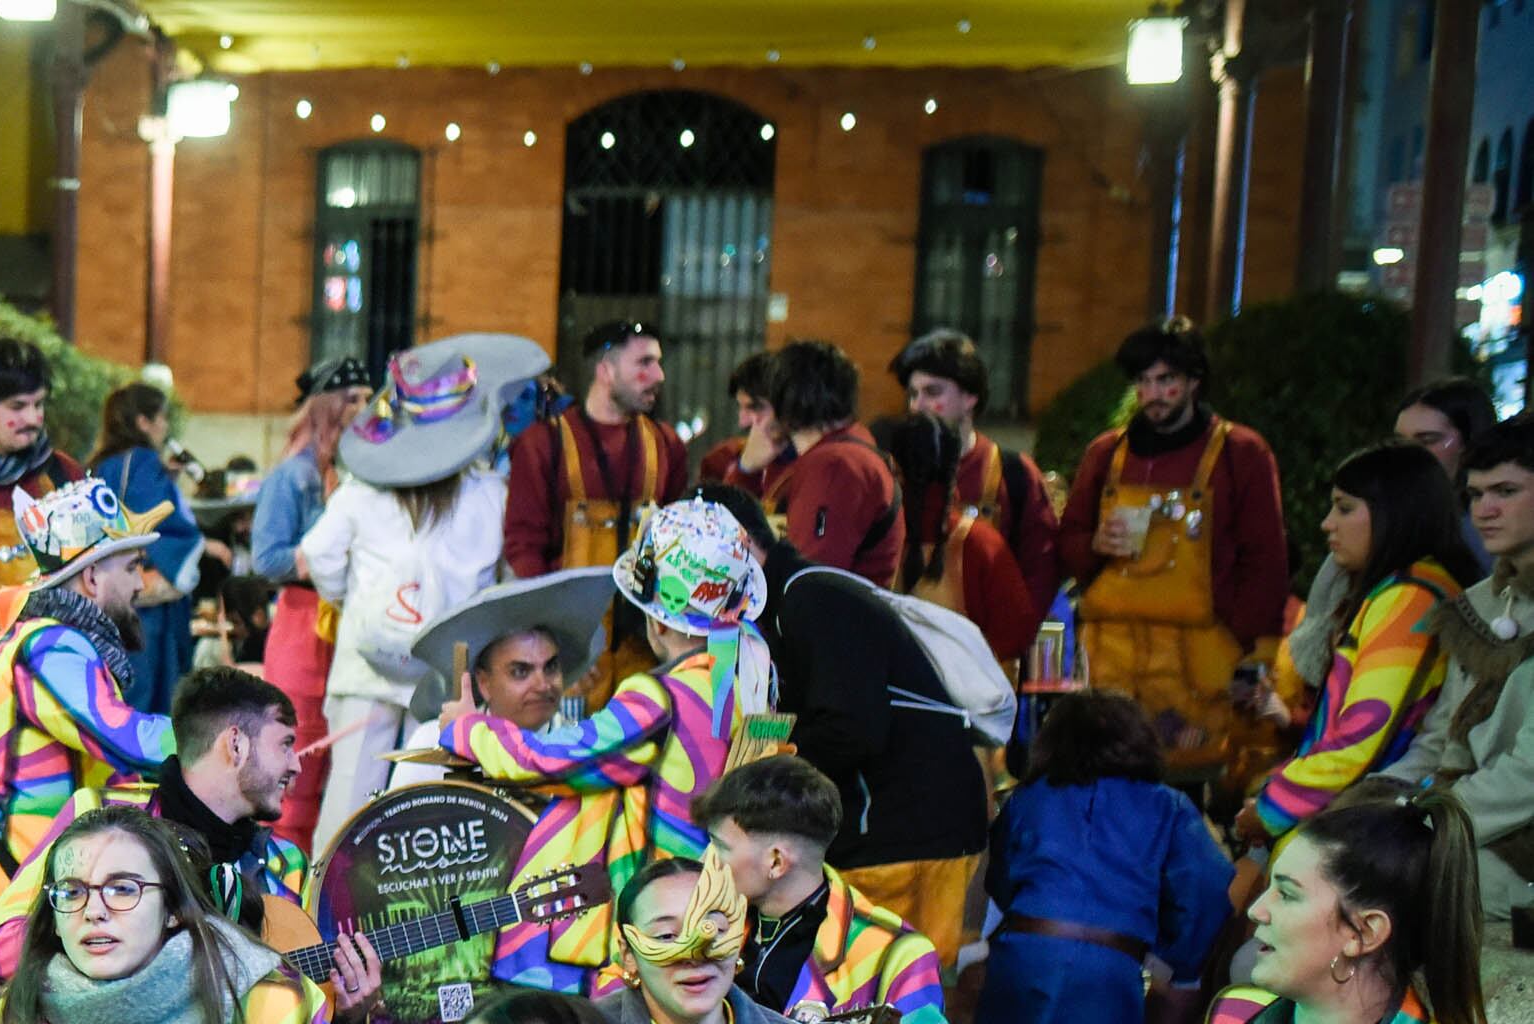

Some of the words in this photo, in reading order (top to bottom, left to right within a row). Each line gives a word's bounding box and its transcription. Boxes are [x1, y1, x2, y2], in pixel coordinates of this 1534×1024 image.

[412, 795, 445, 808] ROMANO
[446, 795, 457, 804] DE
[377, 819, 487, 864] STONE
[380, 852, 489, 876] music
[377, 877, 429, 895] ESCUCHAR
[438, 873, 457, 885] VER
[466, 867, 500, 881] SENTIR
